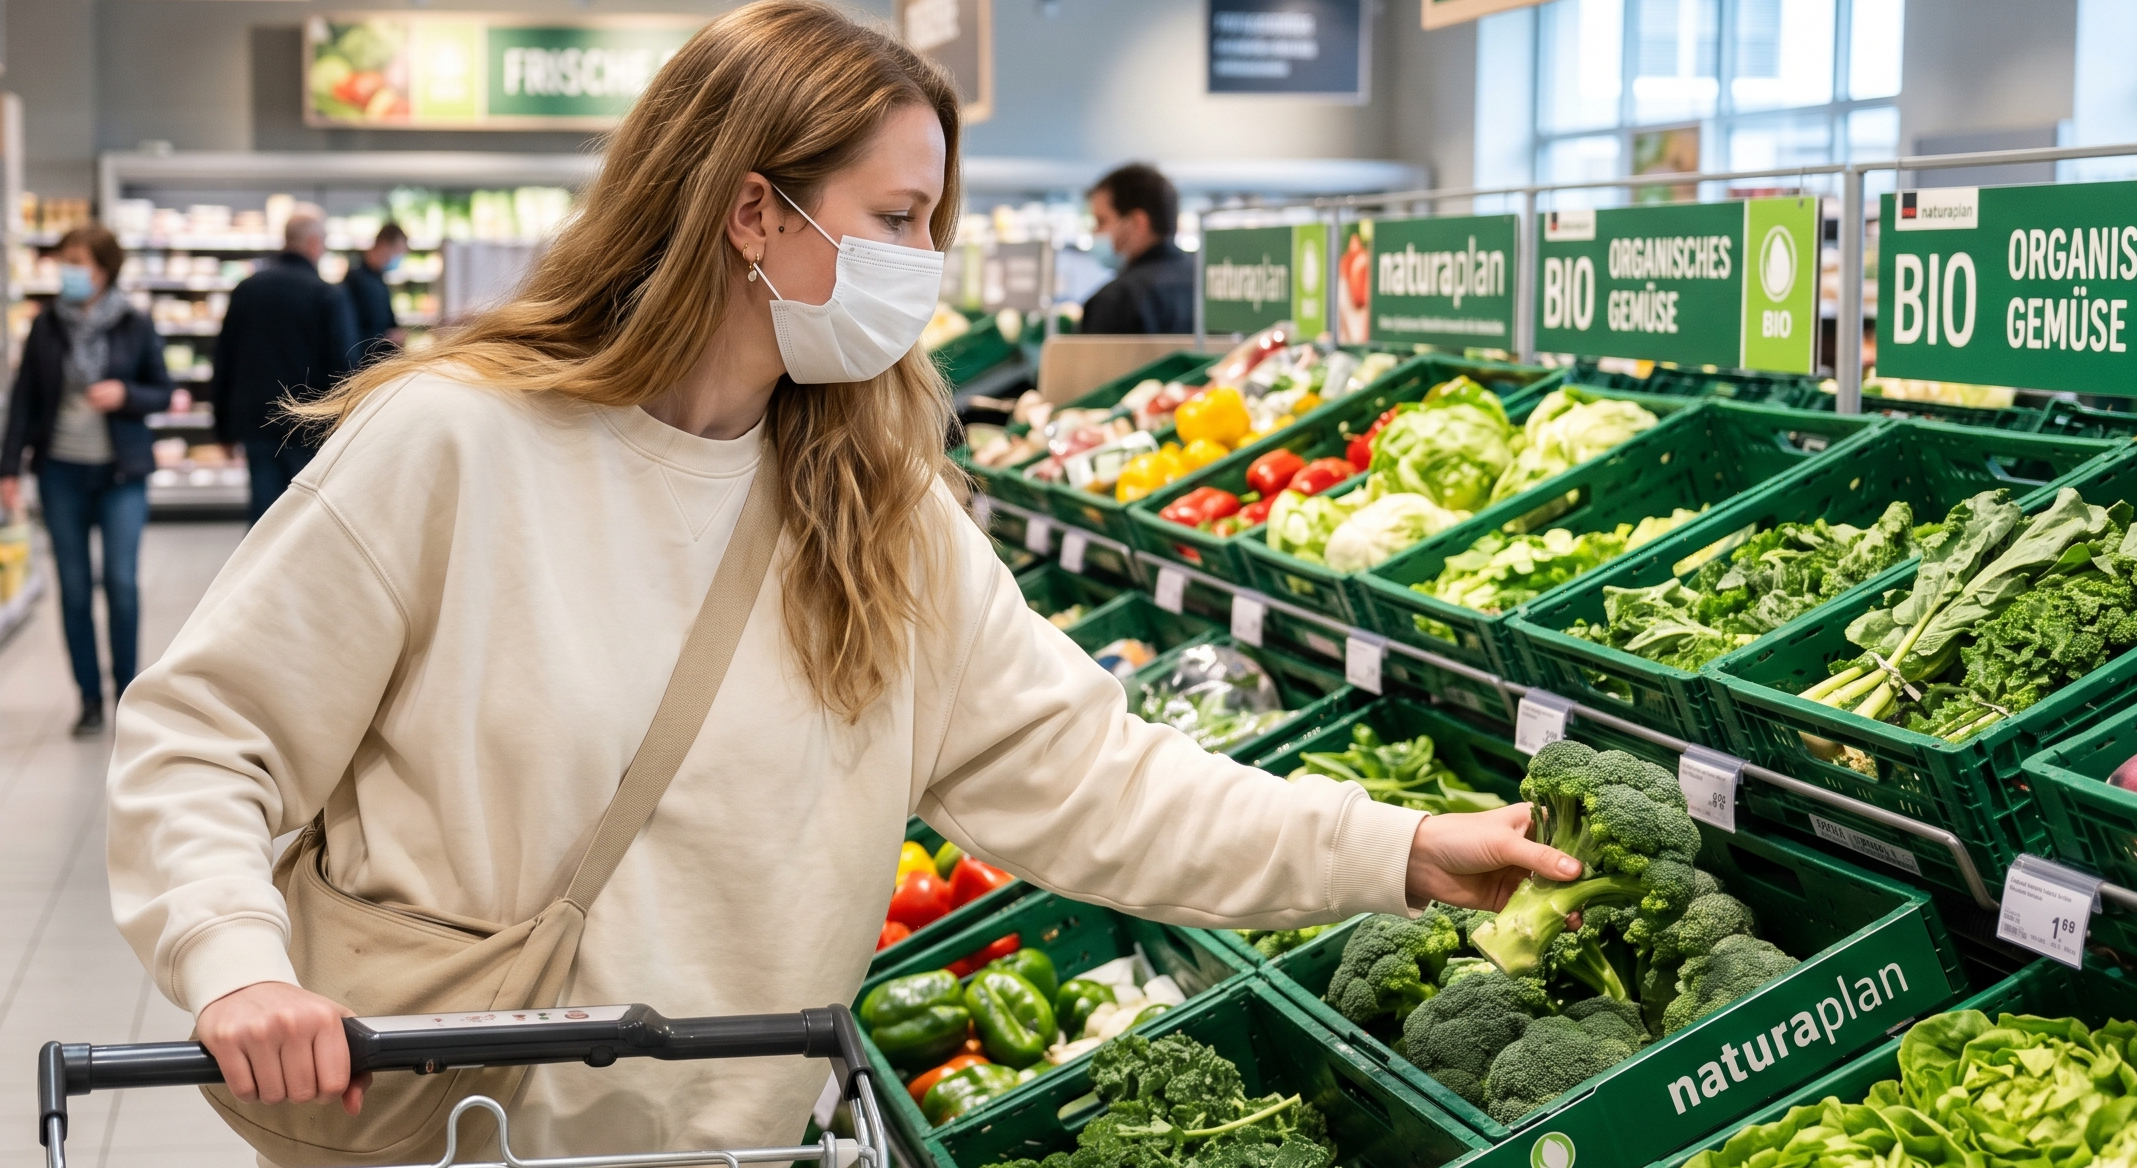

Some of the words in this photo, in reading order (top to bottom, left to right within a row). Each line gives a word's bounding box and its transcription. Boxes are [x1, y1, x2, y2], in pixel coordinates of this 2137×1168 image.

[1922, 204, 1973, 220] naturaplan
[1205, 253, 1289, 312] naturaplan
[1379, 235, 1506, 310] naturaplan
[1609, 235, 1733, 280] ORGANISCHES
[1543, 255, 1596, 331] BIO
[1607, 282, 1680, 333] GEMÜSE
[1893, 252, 1977, 348] BIO
[2006, 286, 2127, 352] GEMÜSE
[1762, 310, 1792, 339] BIO
[1667, 962, 1909, 1115] naturaplan
